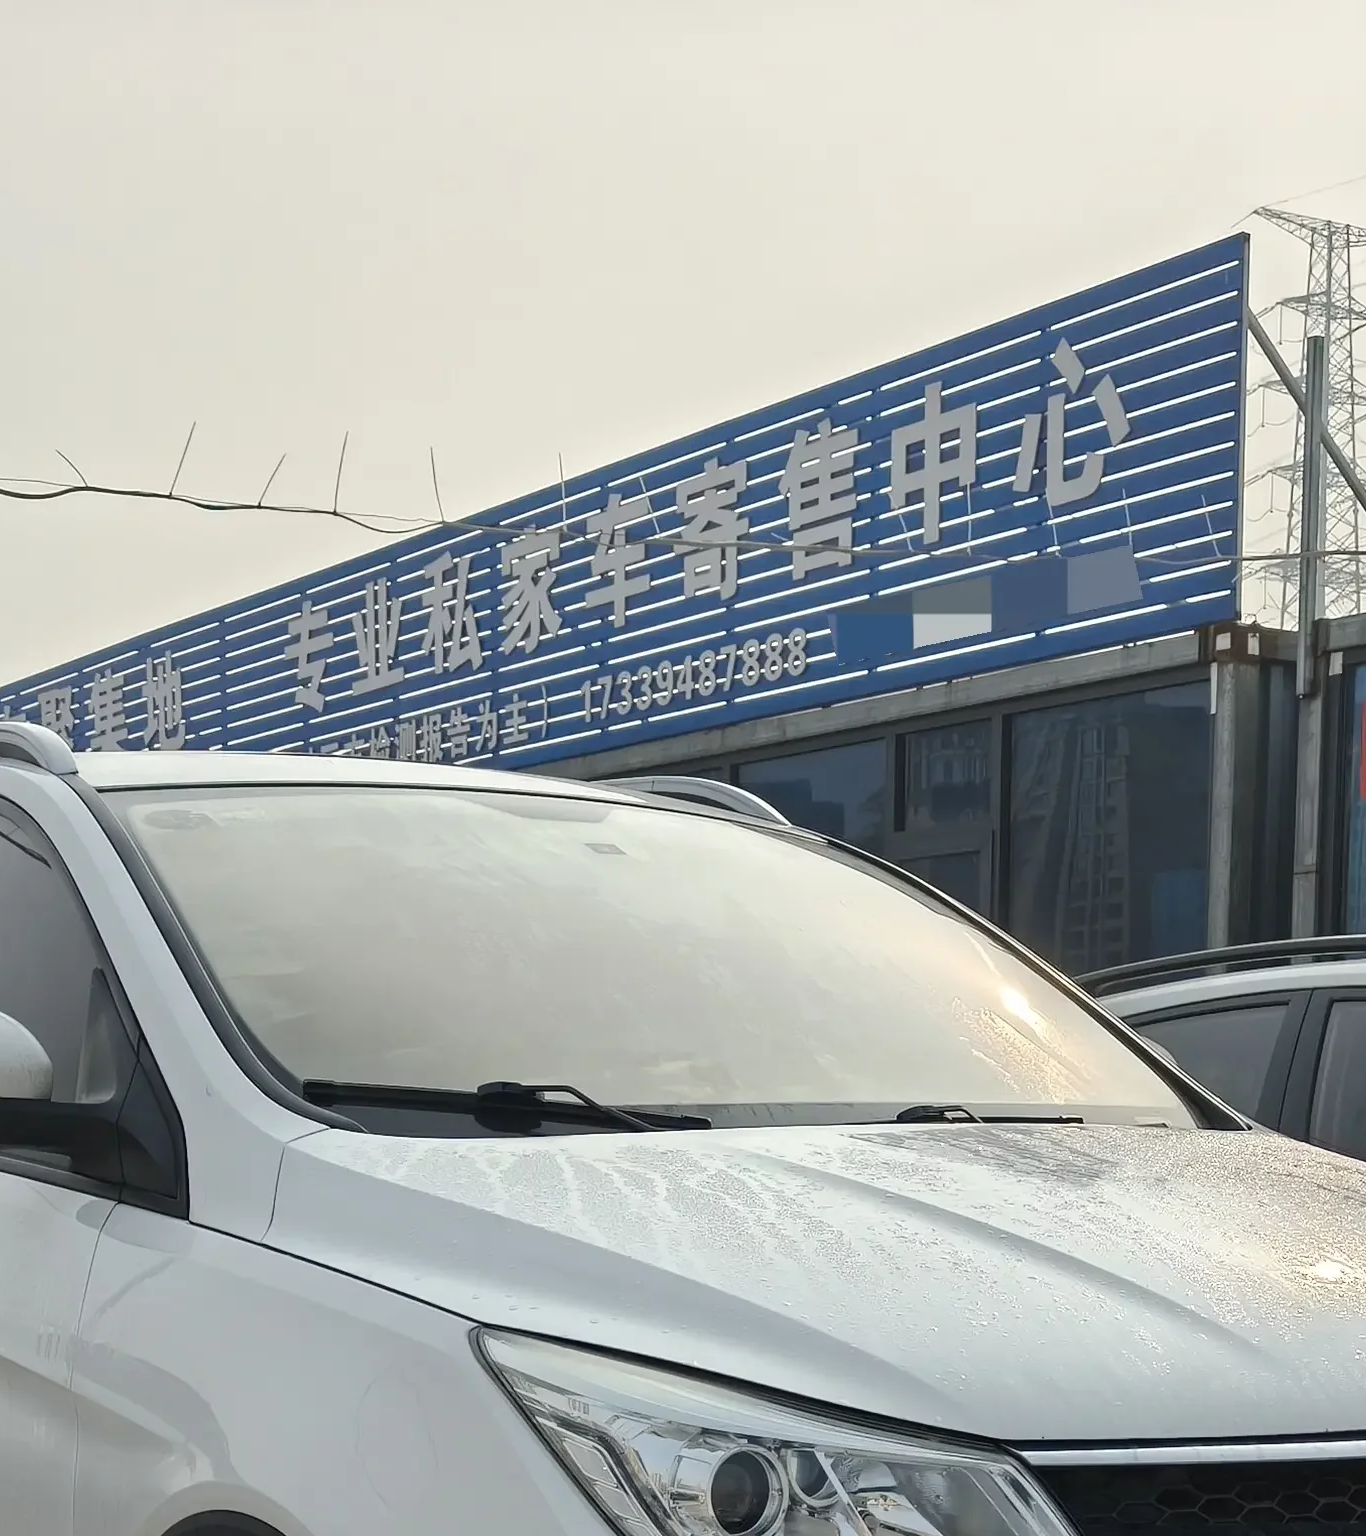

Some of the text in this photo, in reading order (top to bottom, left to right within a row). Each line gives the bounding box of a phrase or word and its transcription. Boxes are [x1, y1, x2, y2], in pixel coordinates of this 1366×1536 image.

[285, 336, 1131, 712] 专业私家车寄售中心
[580, 627, 807, 723] 17339487888
